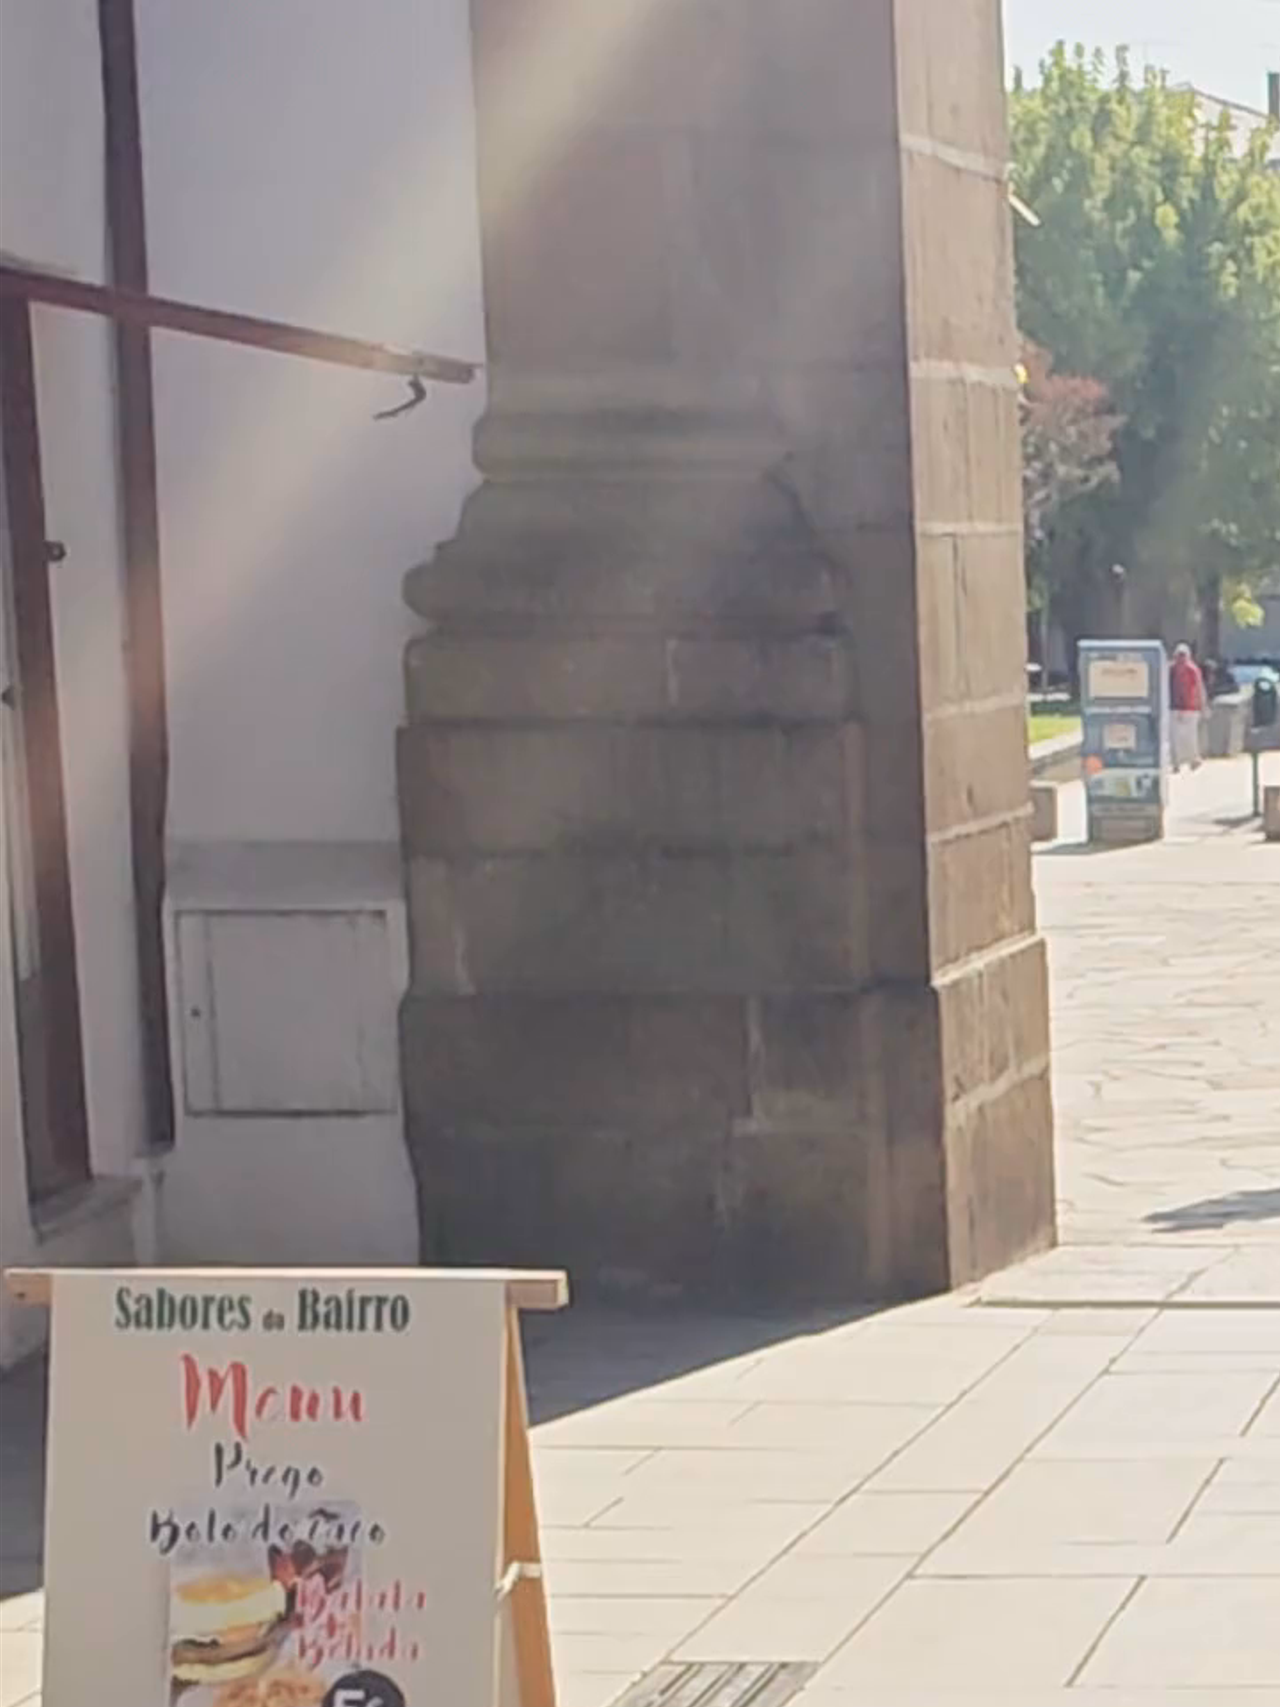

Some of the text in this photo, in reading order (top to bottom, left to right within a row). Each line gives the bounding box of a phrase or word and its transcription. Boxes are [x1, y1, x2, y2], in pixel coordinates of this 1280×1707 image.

[114, 1286, 252, 1331] Sabores
[297, 1287, 410, 1332] Bairro
[181, 1353, 363, 1442] Menu
[214, 1441, 324, 1500] Prego
